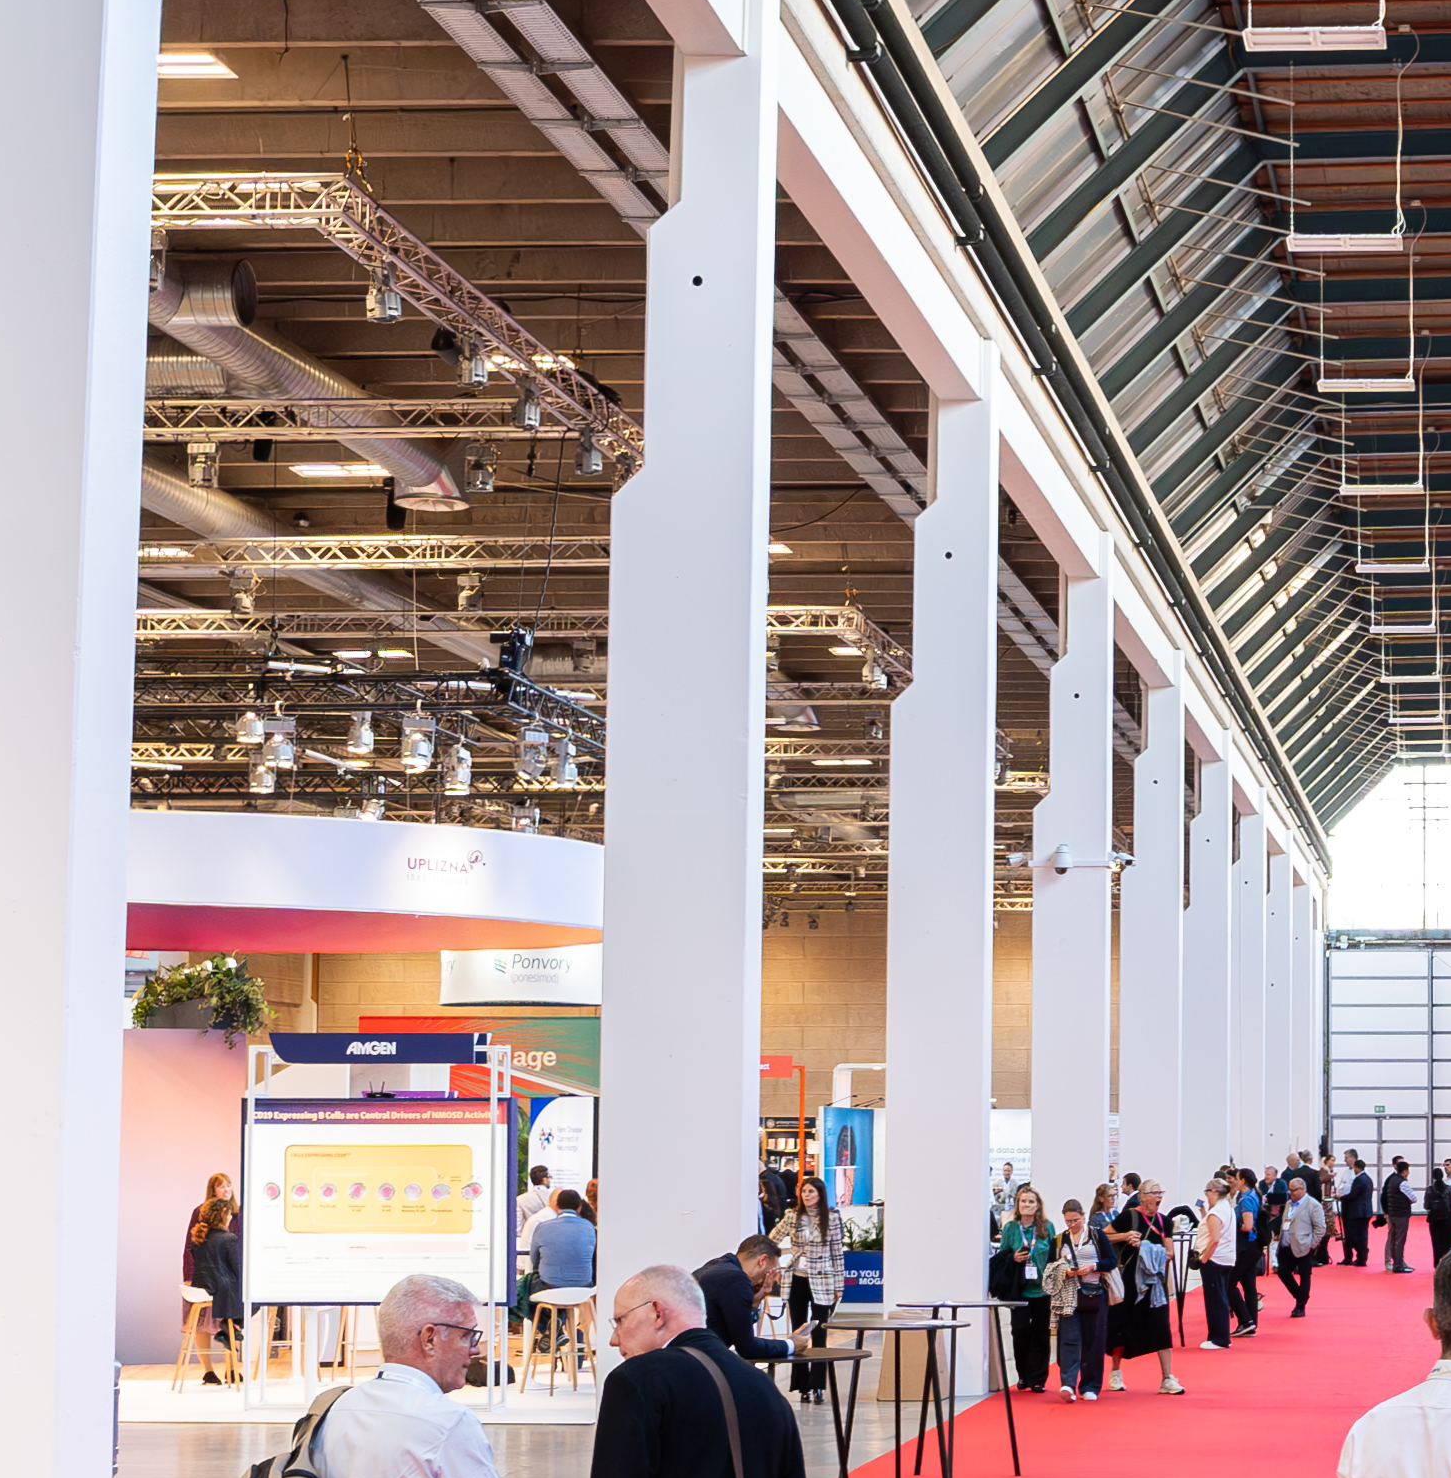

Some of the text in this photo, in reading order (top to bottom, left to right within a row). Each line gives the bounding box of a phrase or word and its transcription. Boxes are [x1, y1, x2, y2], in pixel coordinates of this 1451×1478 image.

[407, 857, 468, 873] UPLIZNA
[512, 953, 573, 973] Ponvory
[345, 1040, 397, 1055] AMGEN
[859, 1270, 880, 1278] YOU
